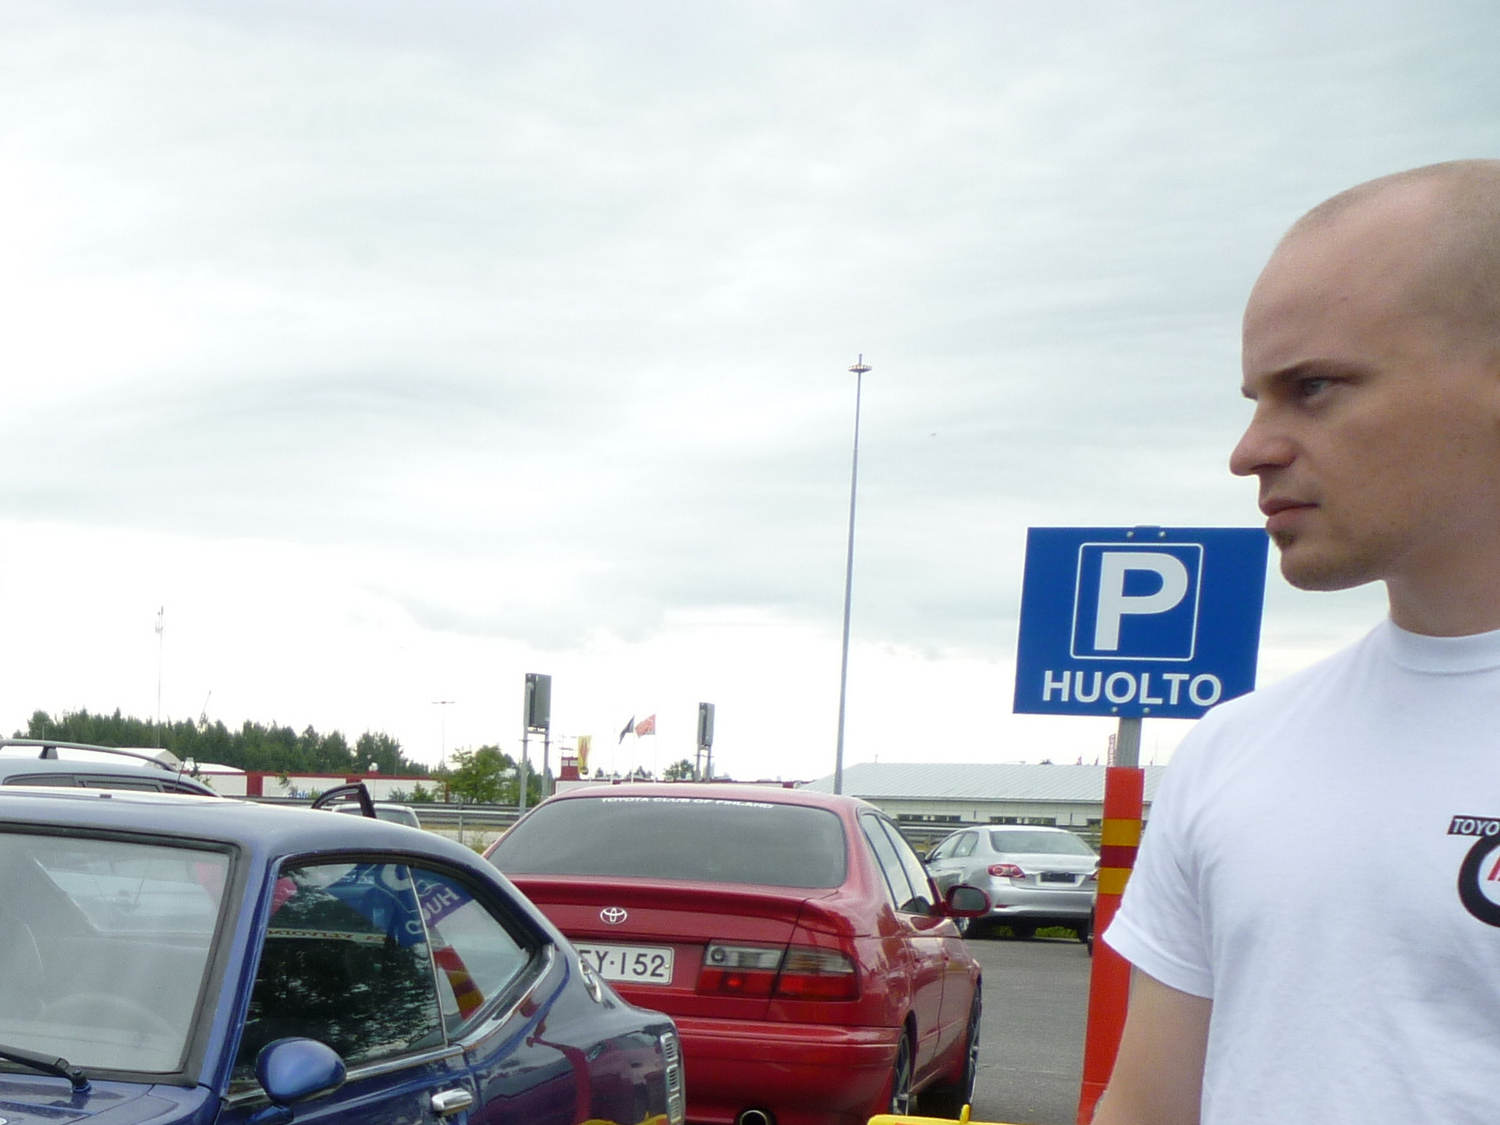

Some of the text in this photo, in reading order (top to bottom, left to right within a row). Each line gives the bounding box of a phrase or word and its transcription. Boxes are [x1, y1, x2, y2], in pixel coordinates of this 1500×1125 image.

[1093, 552, 1188, 650] P
[1042, 670, 1222, 706] HUOLTO
[715, 800, 774, 809] FINLAND
[578, 949, 666, 978] Y-152
